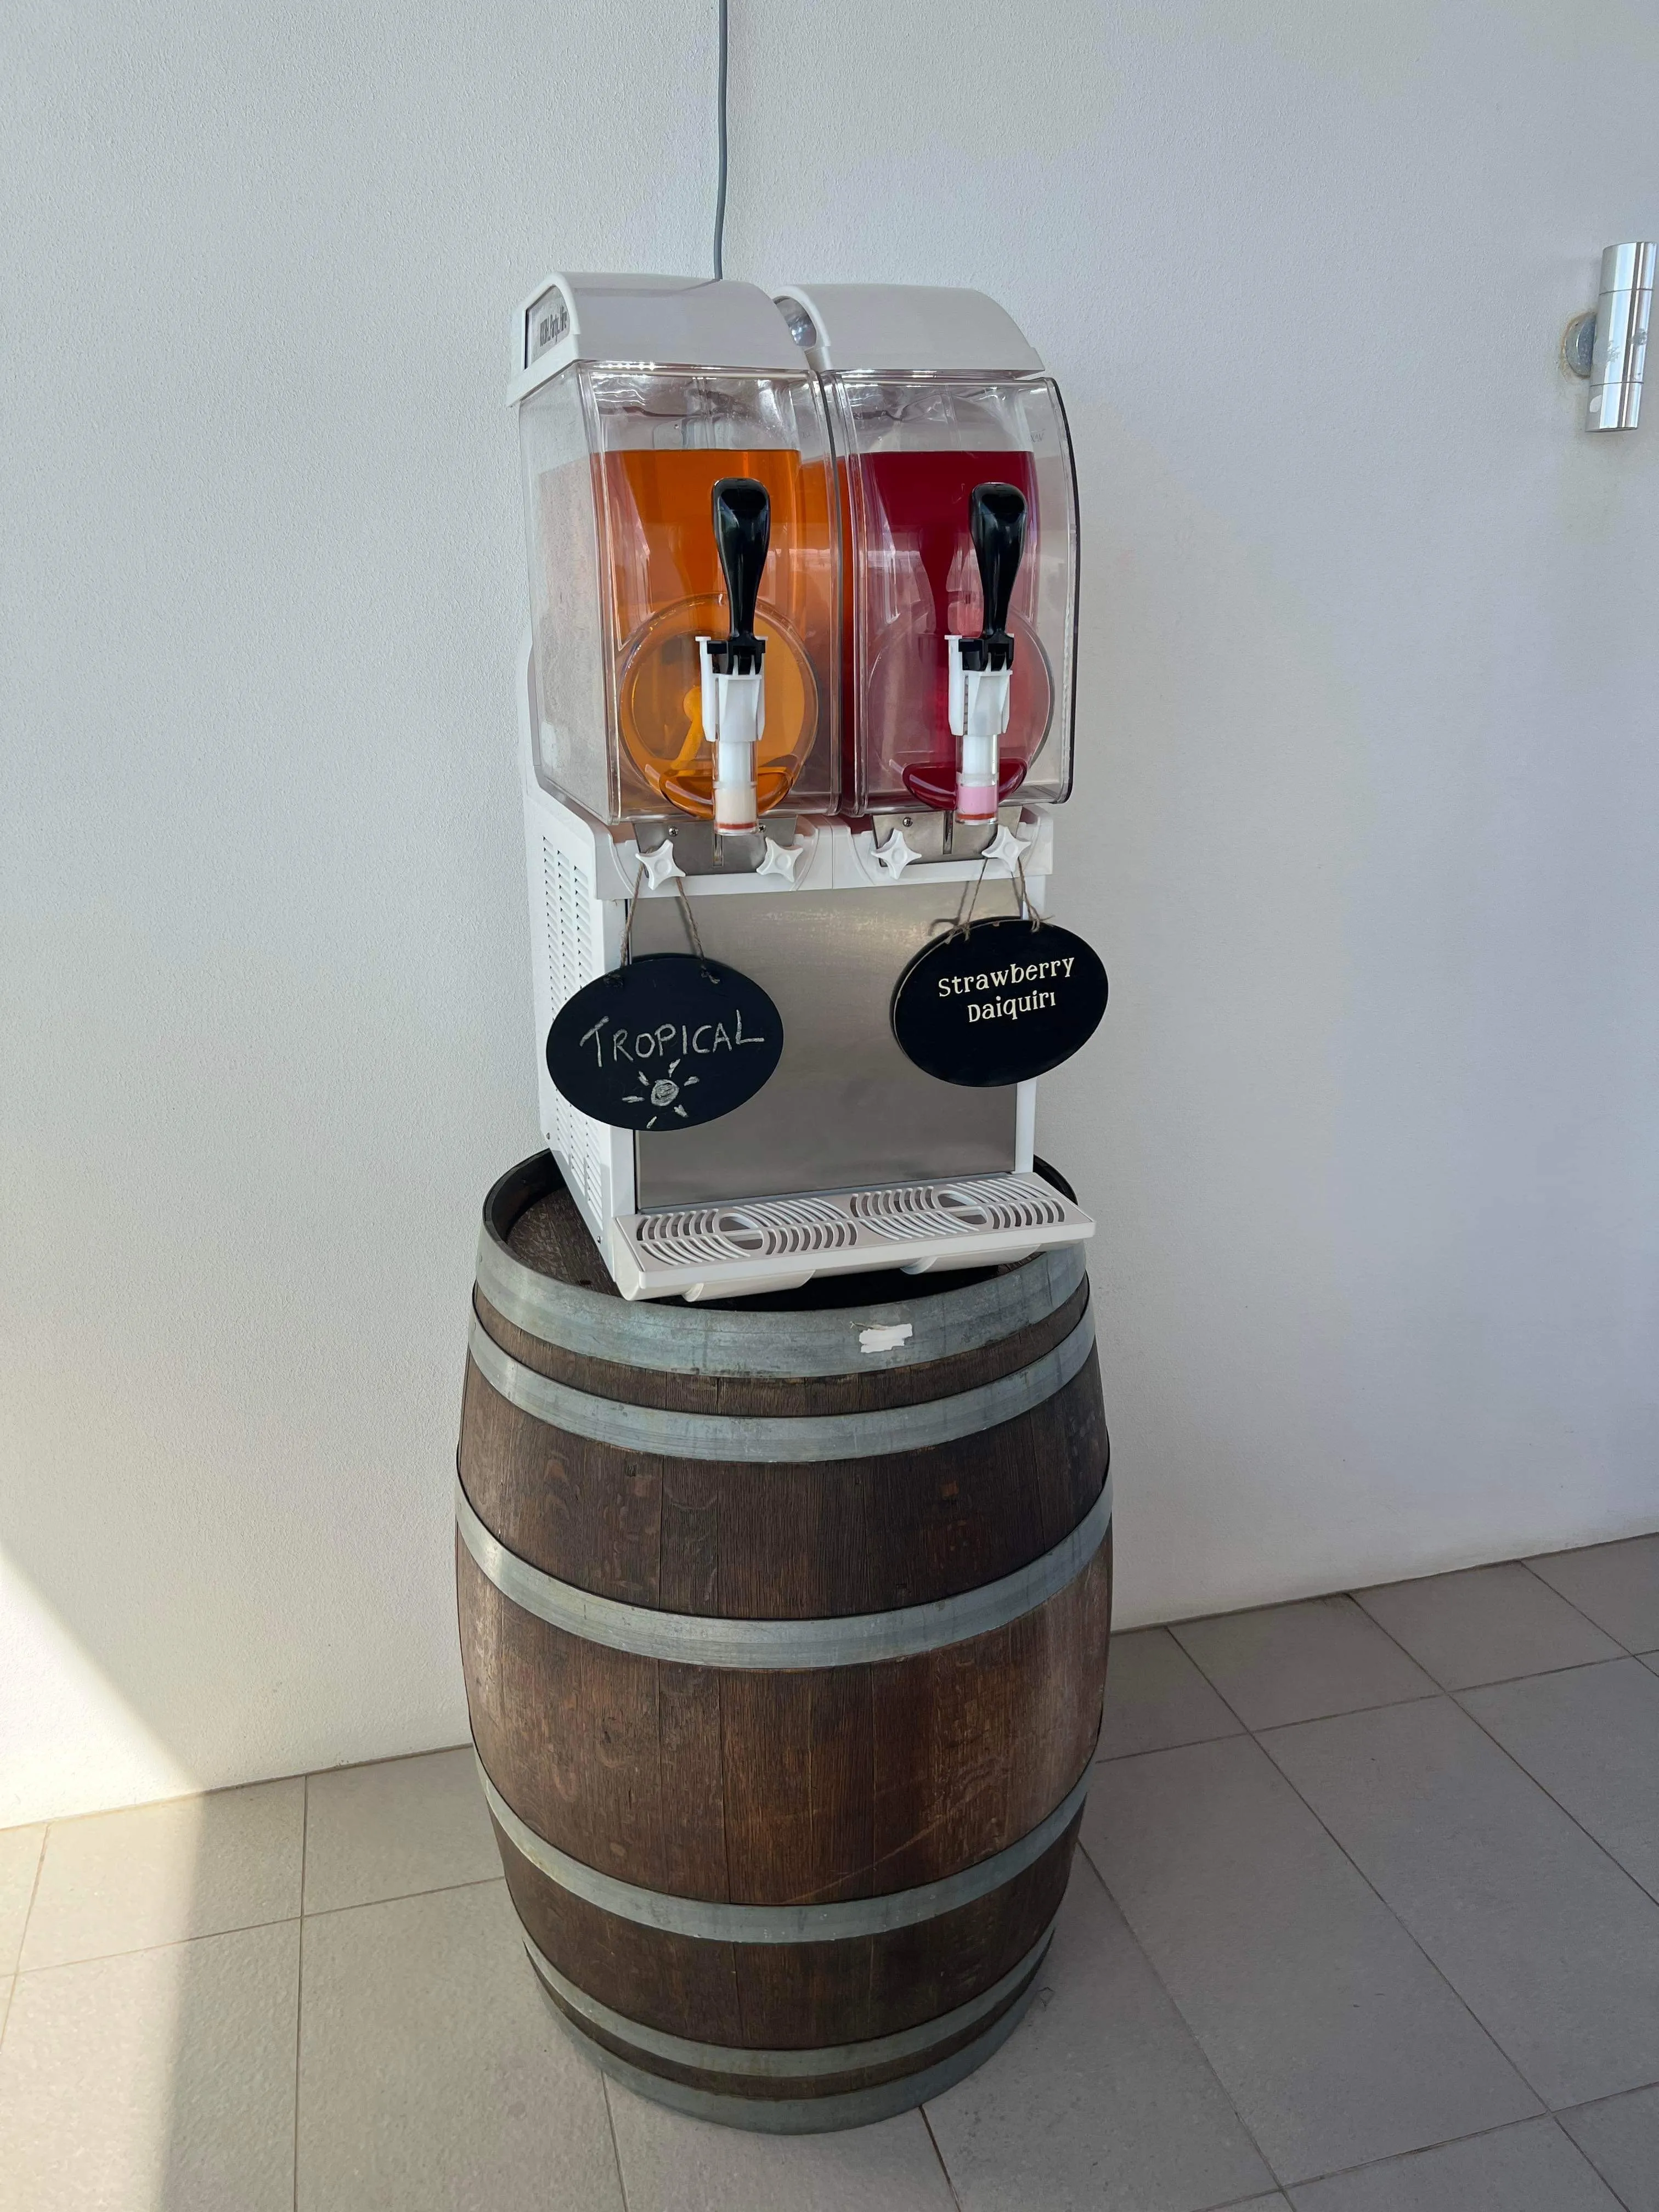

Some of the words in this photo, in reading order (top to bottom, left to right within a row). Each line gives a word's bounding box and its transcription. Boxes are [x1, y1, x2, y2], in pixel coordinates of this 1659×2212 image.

[938, 957, 1075, 997] Strawberry
[967, 990, 1057, 1023] Daiquiri
[579, 1009, 765, 1067] TROPICAL
